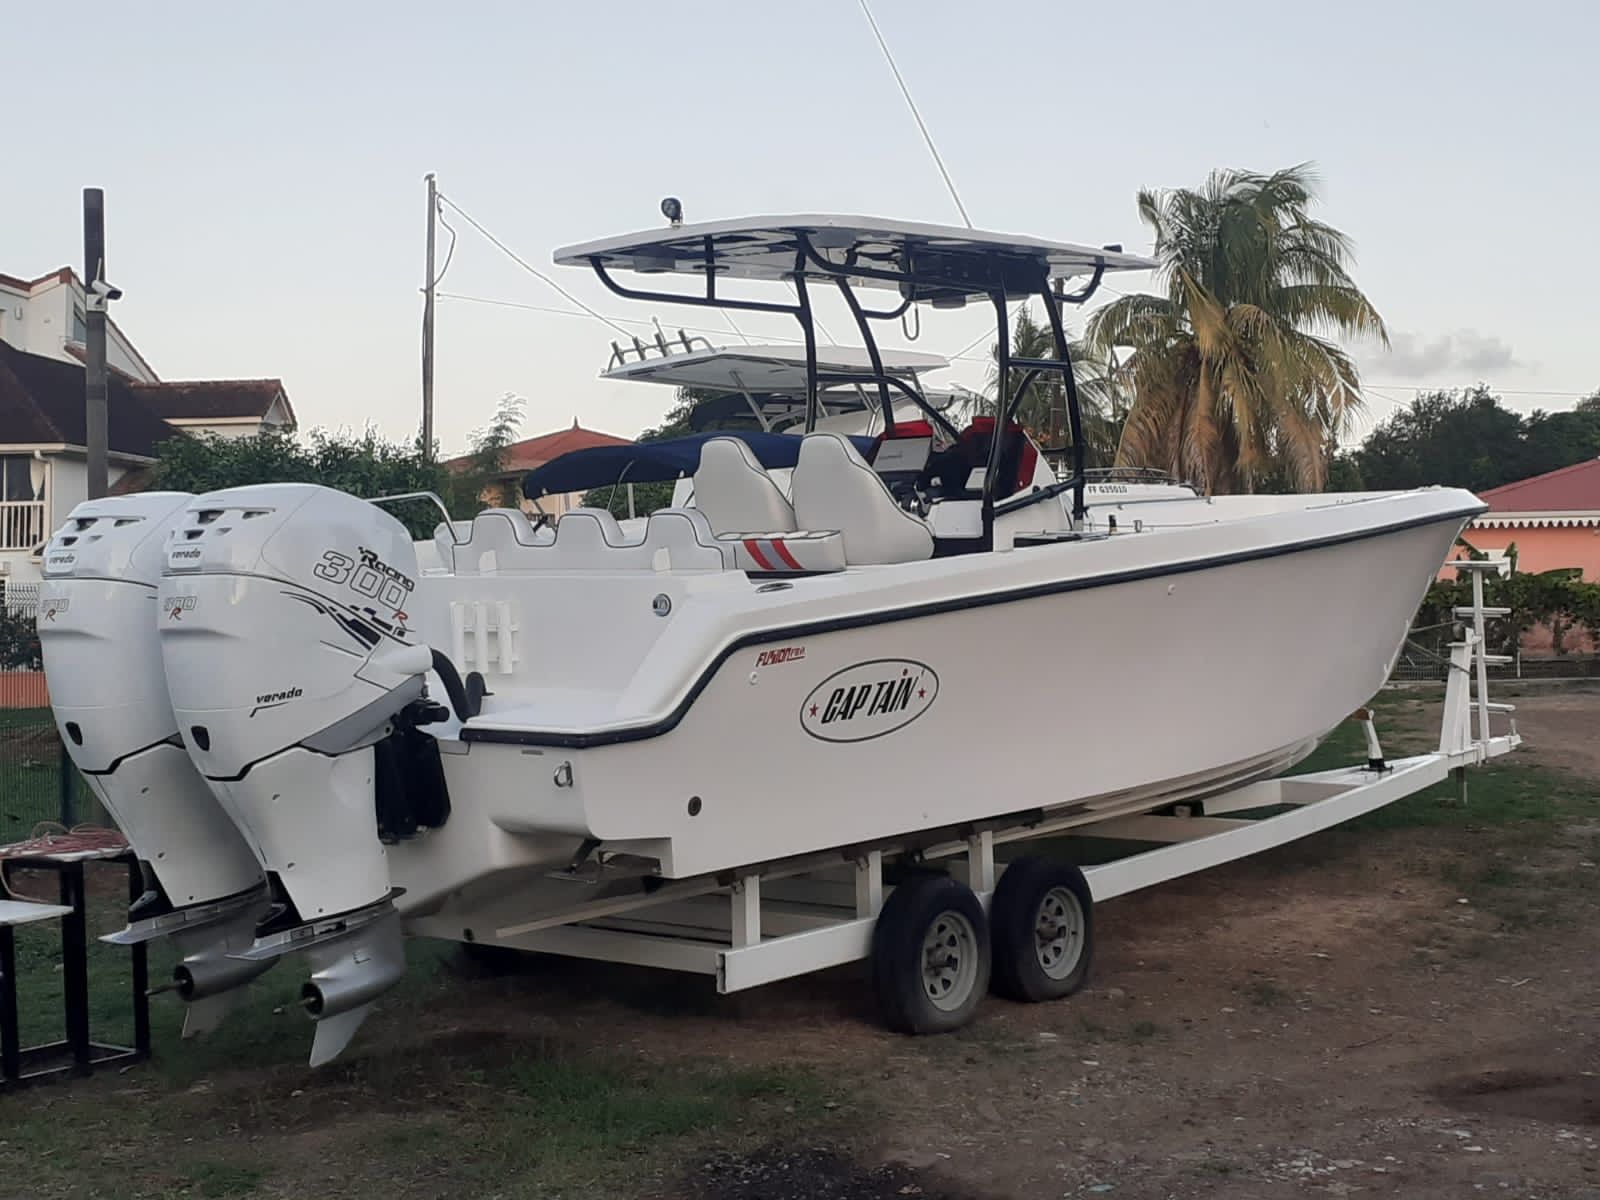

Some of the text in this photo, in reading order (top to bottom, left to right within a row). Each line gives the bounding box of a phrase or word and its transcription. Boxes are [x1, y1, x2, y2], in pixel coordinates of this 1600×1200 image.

[313, 550, 408, 612] 300
[358, 546, 415, 592] Racing
[256, 687, 303, 704] verado
